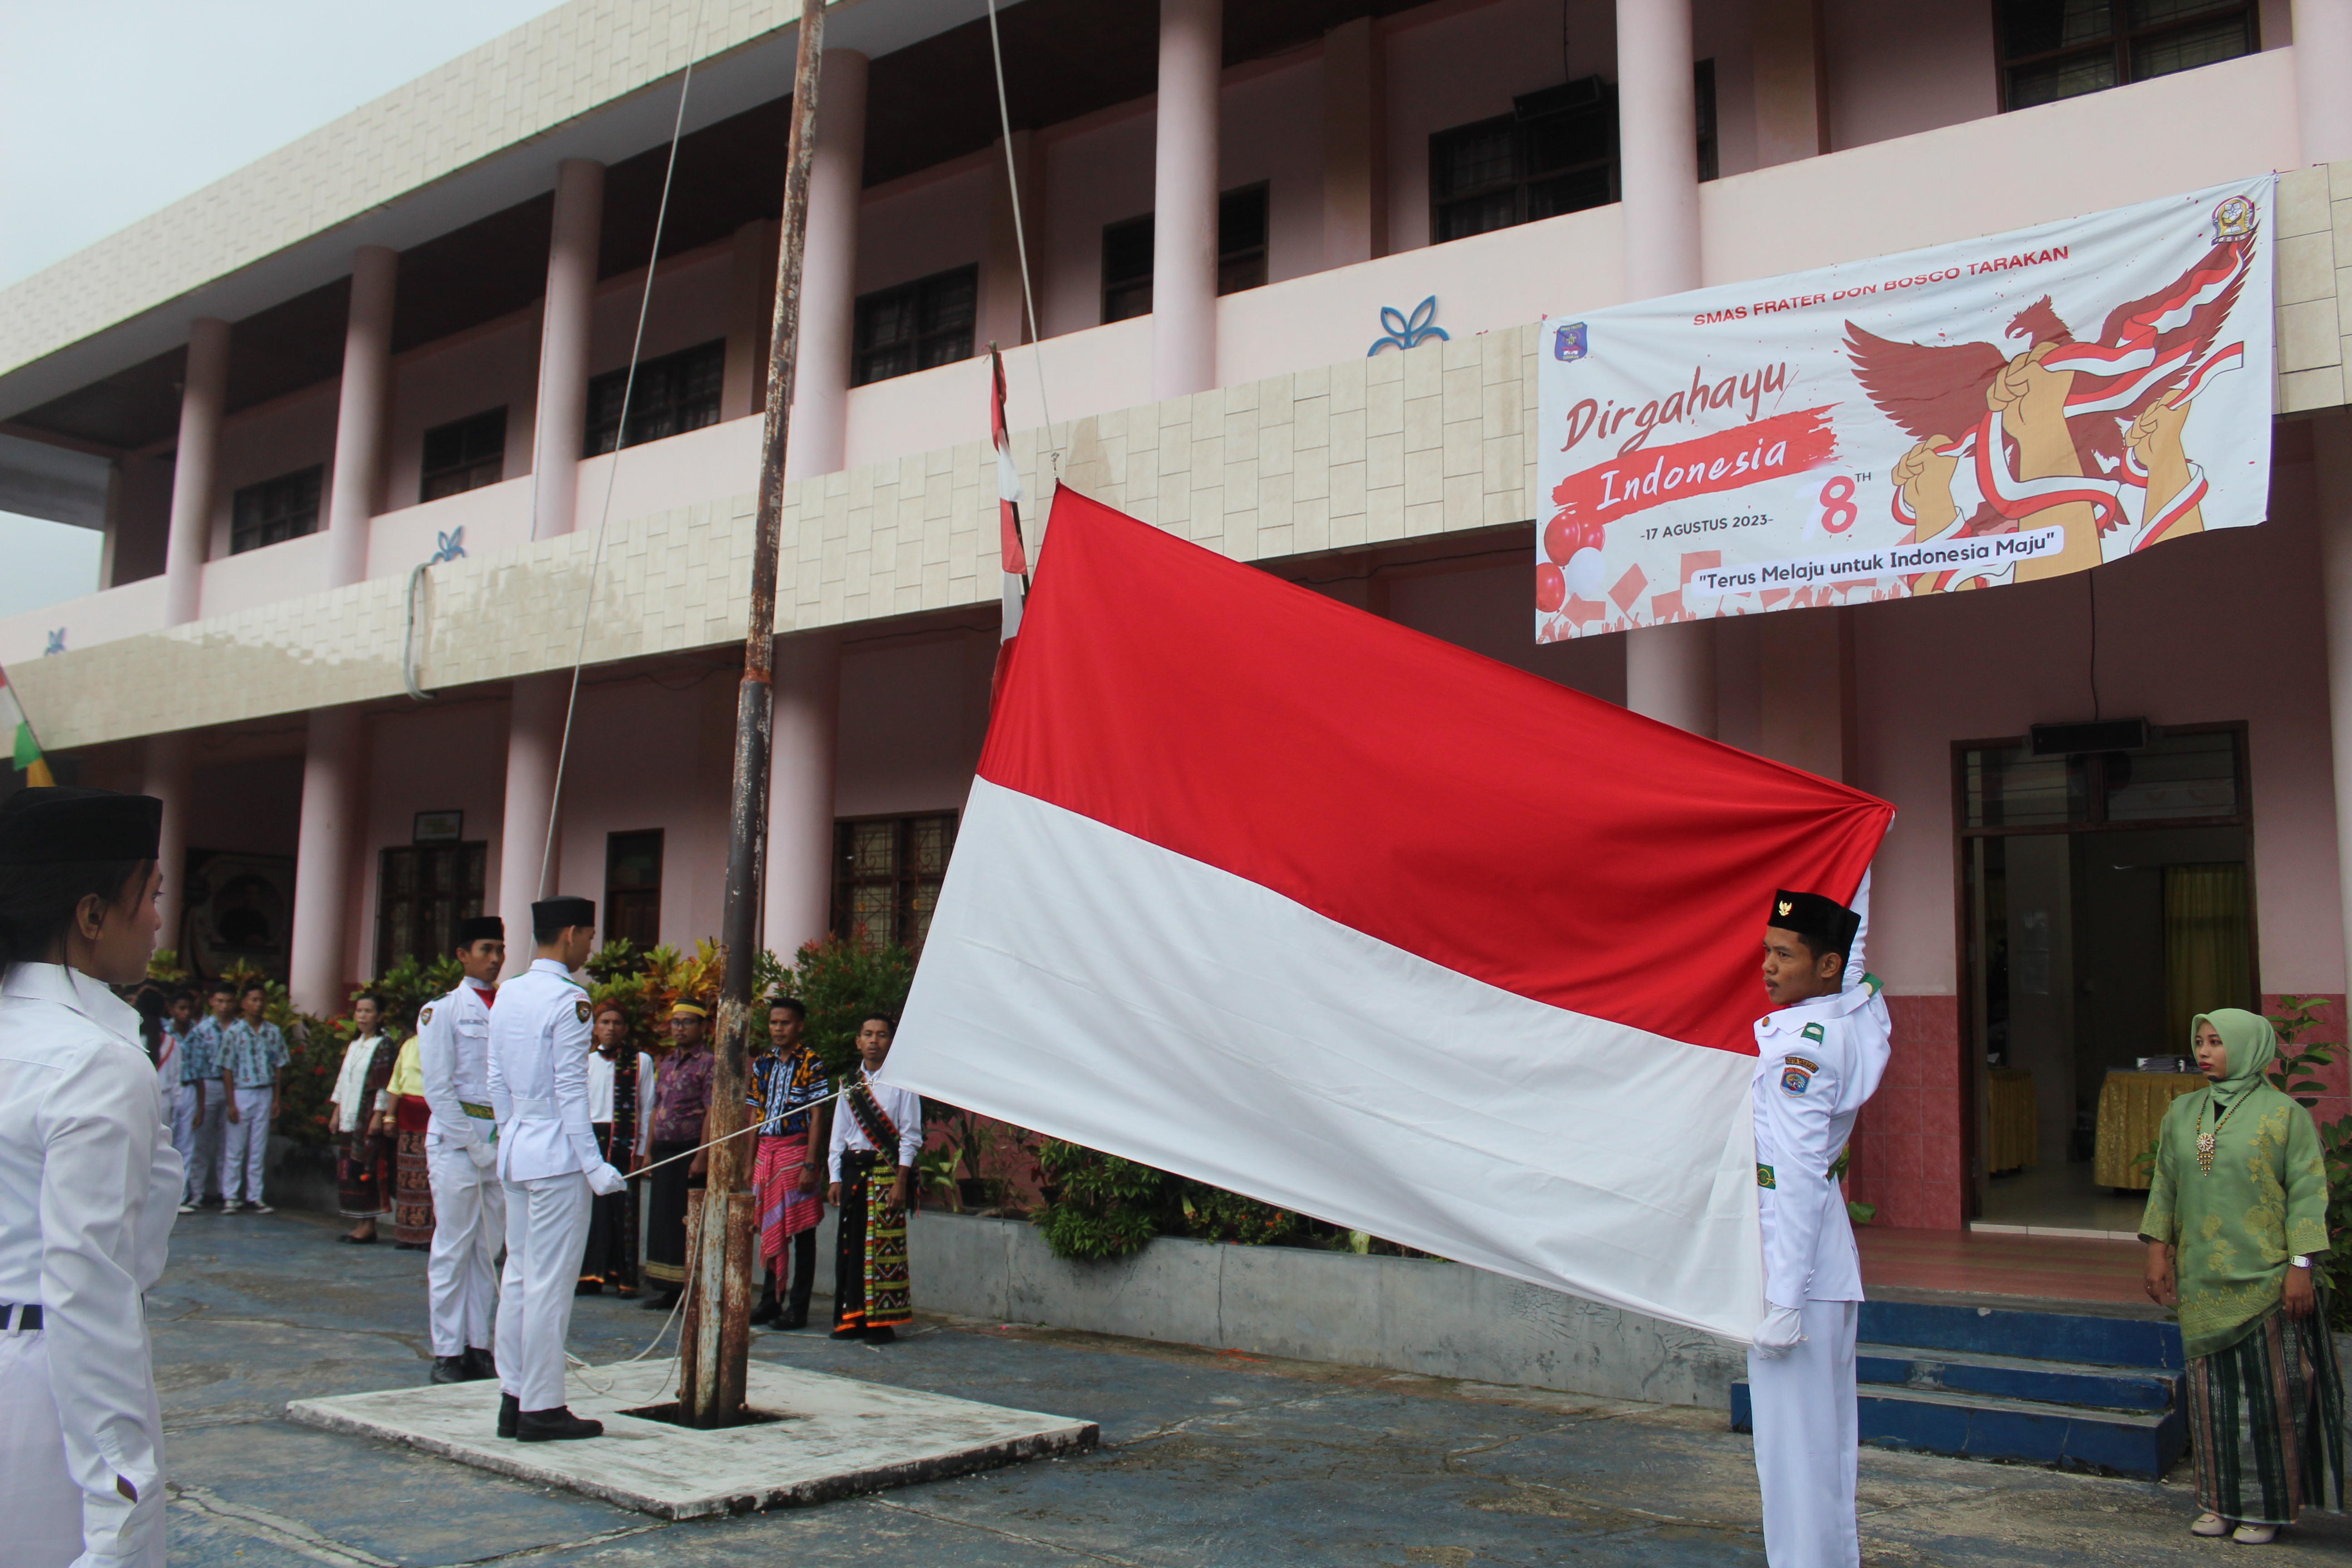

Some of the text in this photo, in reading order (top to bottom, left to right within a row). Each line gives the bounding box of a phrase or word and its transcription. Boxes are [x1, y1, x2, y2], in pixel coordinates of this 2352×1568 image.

[1693, 246, 2068, 325] SMAS FRATER DON BOSCO TARAKAN
[1560, 362, 1785, 458] Dirgahayu
[1596, 438, 1787, 510] Indonesia
[1640, 514, 1774, 540] -17 AGUSTUS 2023-
[1699, 532, 2054, 588] "Terus Melaju untuk Indonesia Maju"
